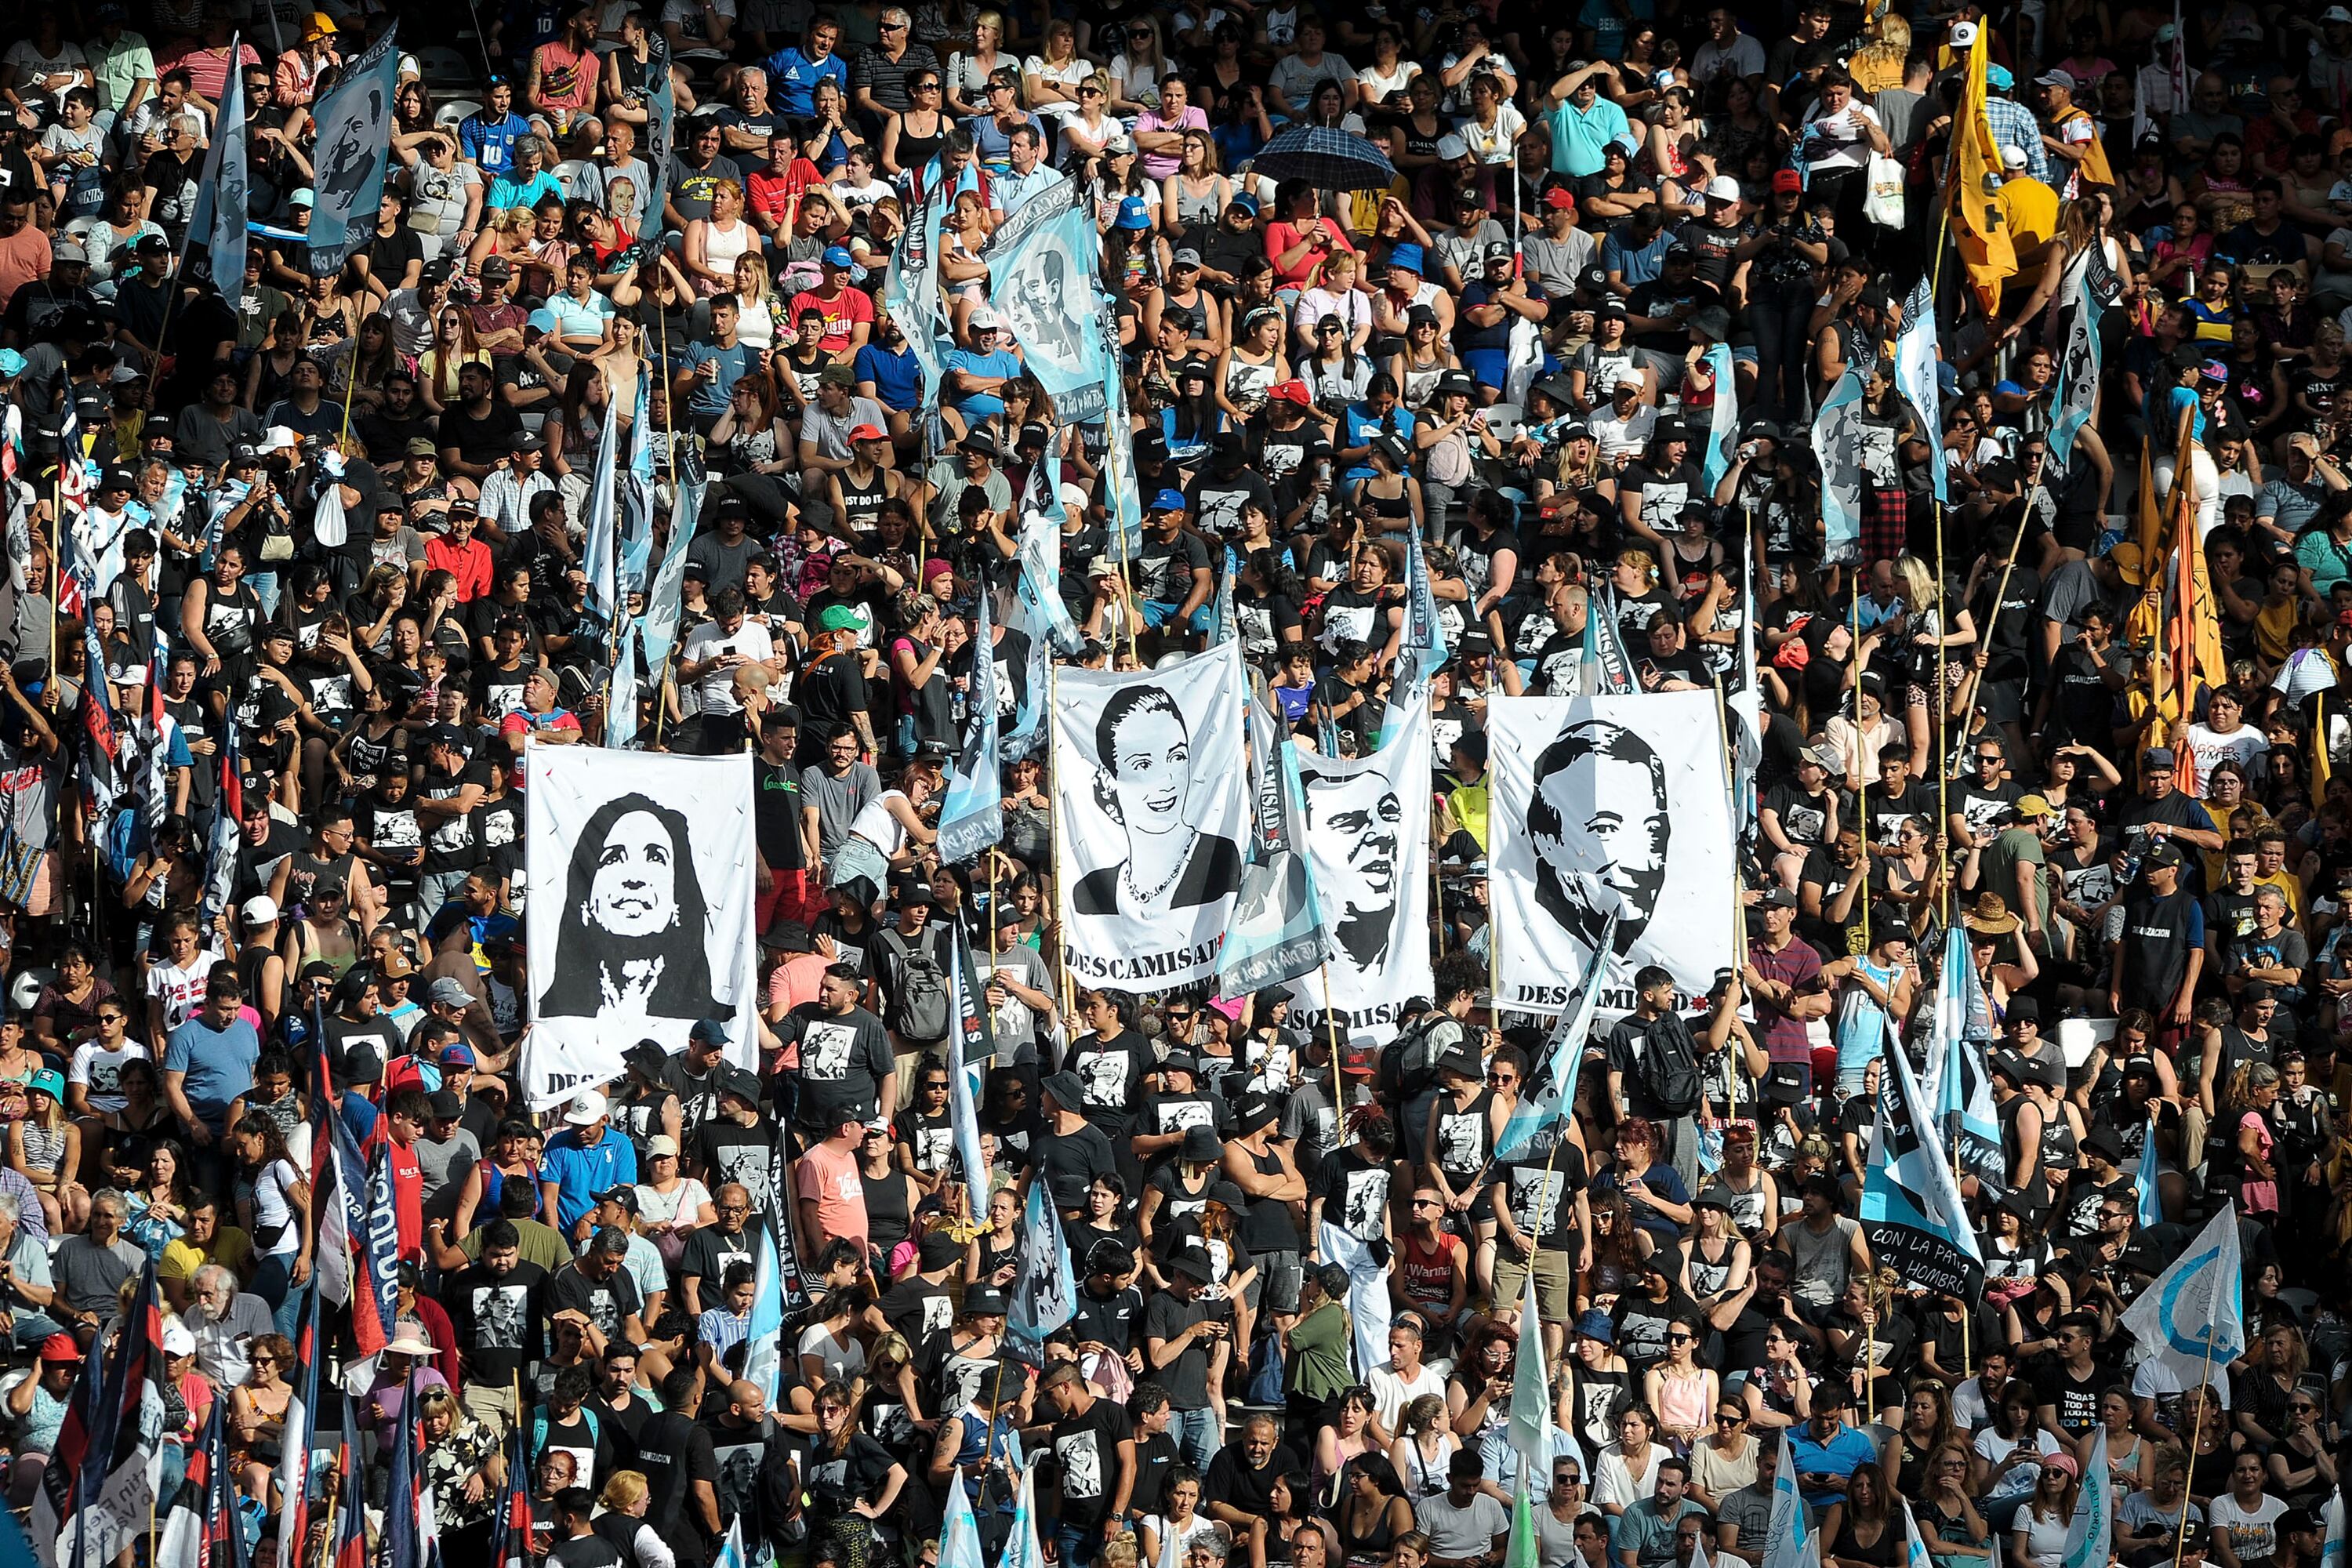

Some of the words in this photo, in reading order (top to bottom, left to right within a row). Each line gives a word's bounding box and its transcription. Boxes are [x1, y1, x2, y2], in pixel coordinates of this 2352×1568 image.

[536, 17, 554, 34] 10
[482, 145, 503, 165] 10
[859, 495, 871, 506] DO
[1872, 1228, 1905, 1250] CON
[1910, 1238, 1932, 1261] LA
[1410, 1263, 1451, 1278] Wanna
[2064, 1391, 2095, 1401] TODAS
